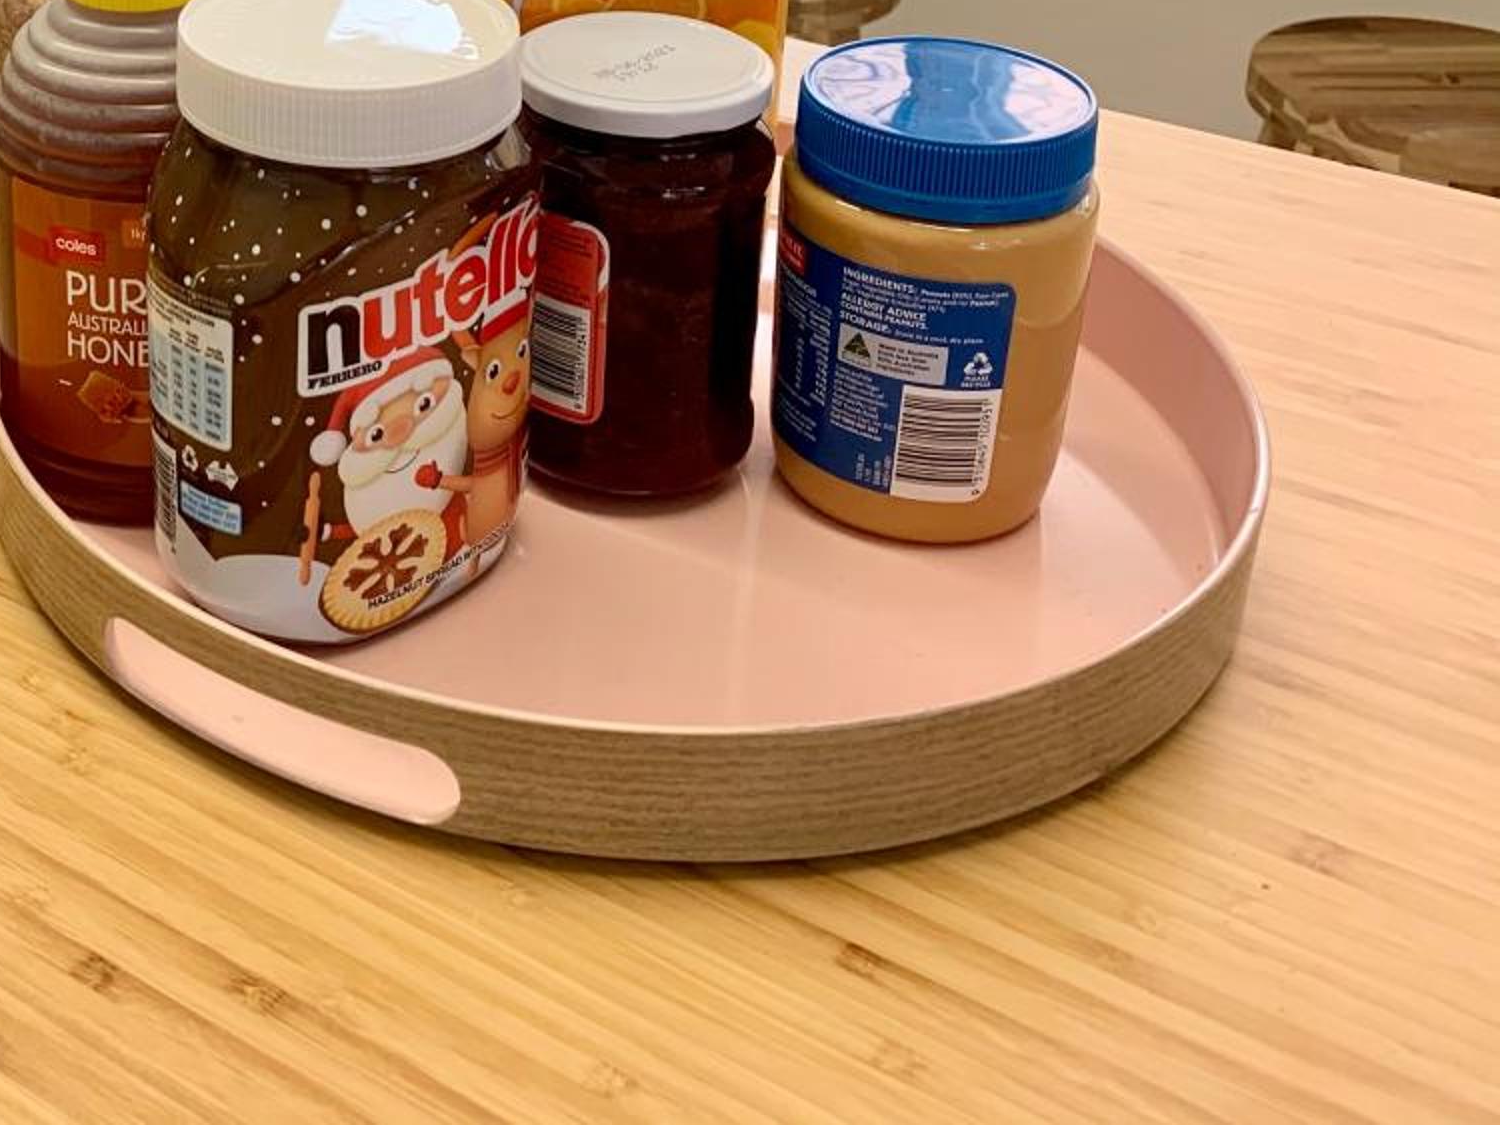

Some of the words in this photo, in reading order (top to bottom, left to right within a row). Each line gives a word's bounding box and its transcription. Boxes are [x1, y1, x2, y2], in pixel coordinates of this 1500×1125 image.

[55, 236, 98, 257] coles
[65, 269, 149, 315] PUR
[305, 205, 539, 377] nutella
[842, 266, 916, 294] INGREDIENTS:
[841, 293, 884, 312] ALLERGY
[887, 306, 927, 322] ADVICE
[67, 310, 149, 336] AUSTRALI
[66, 330, 150, 368] HONE
[307, 360, 382, 390] FERRERO
[367, 577, 424, 611] HAZELNUT
[424, 555, 463, 586] SPREAD
